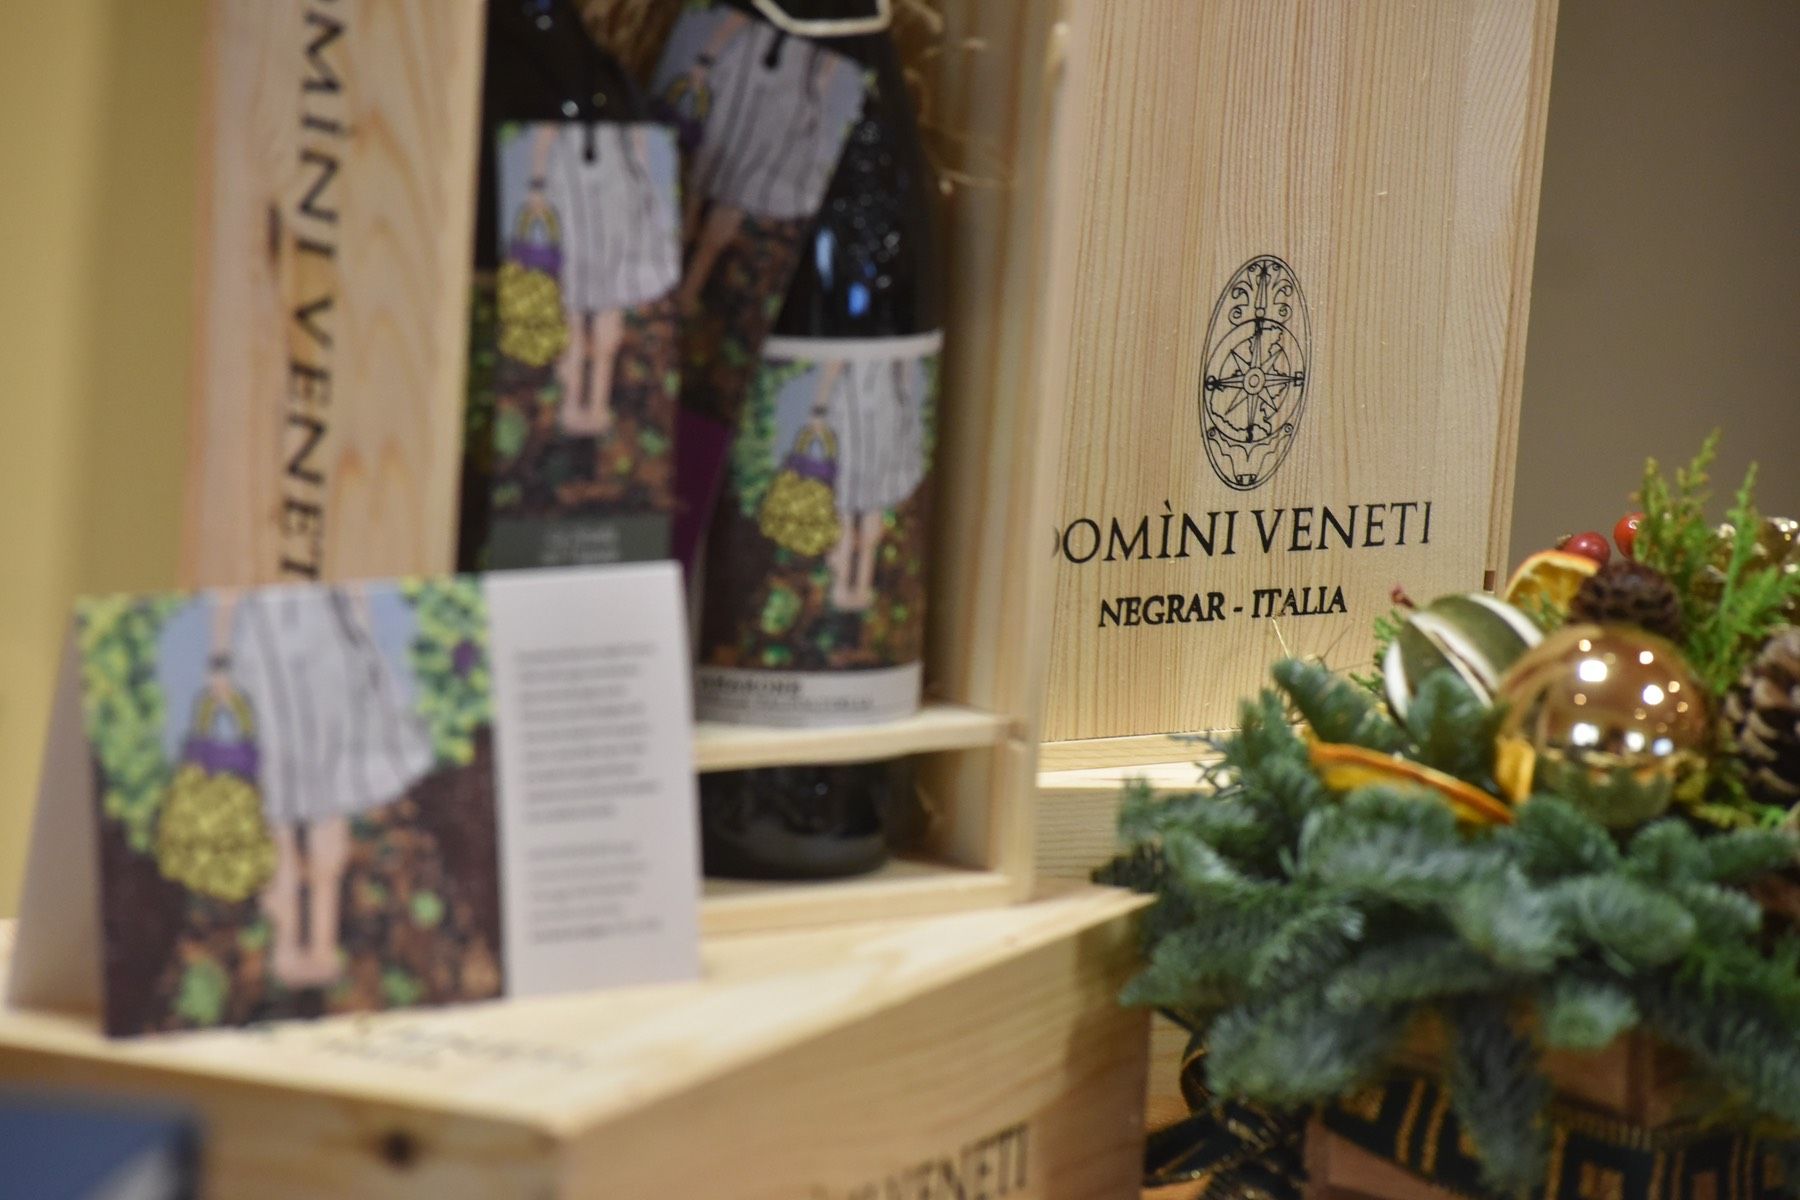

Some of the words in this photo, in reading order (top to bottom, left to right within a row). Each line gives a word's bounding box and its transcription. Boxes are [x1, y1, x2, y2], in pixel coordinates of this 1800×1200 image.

[279, 294, 334, 581] VENET
[1250, 501, 1432, 554] VENETI
[1098, 592, 1226, 627] NEGRAR
[1251, 585, 1348, 618] ITALIA
